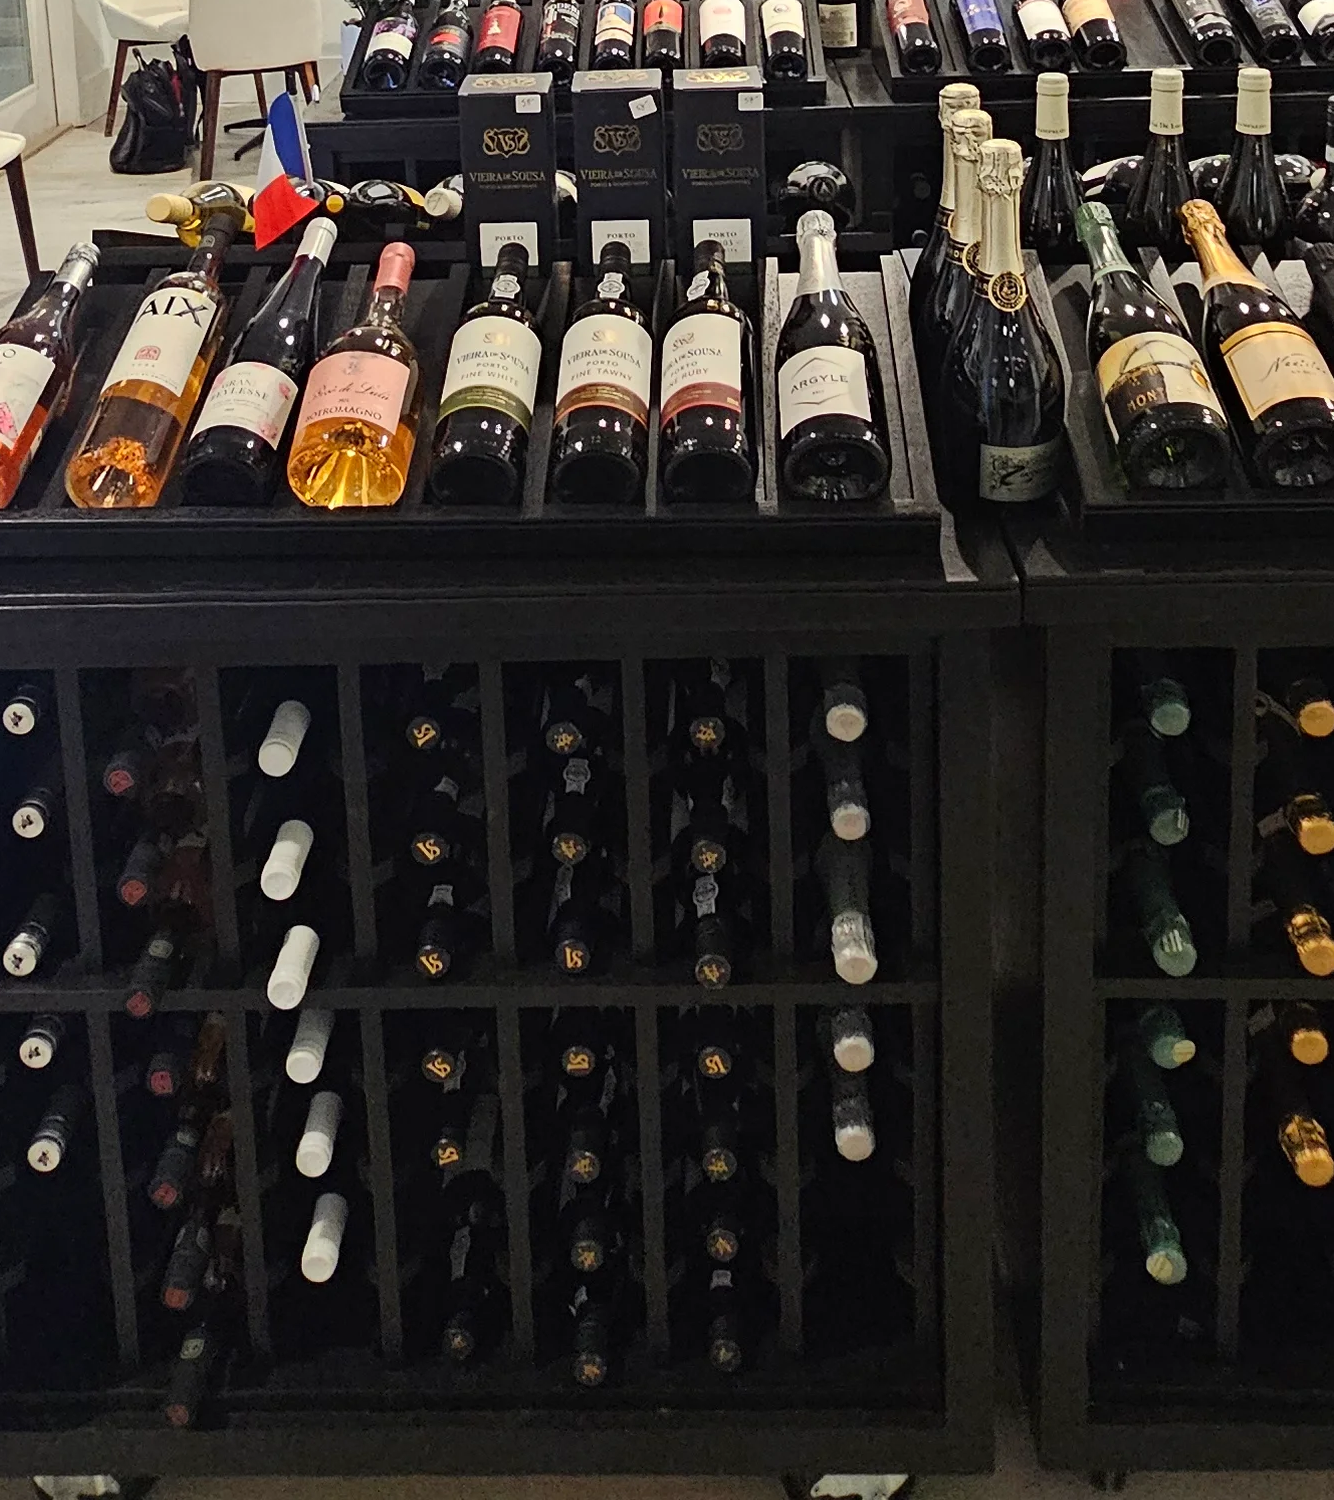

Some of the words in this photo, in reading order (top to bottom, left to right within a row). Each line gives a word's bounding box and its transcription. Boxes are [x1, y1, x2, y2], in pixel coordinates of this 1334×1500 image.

[469, 172, 503, 183] VIEIRA
[512, 171, 546, 182] SOUSA
[580, 169, 614, 180] VIEIRA
[135, 295, 209, 329] AIX
[456, 350, 490, 365] VIEIRA
[566, 350, 599, 367] VIEIRA
[609, 350, 642, 369] SOUSA
[687, 347, 723, 358] SOUSA
[476, 362, 509, 372] PORTO
[596, 368, 633, 382] TAWNY
[681, 368, 709, 382] RUBY
[790, 374, 849, 395] ARGYLE
